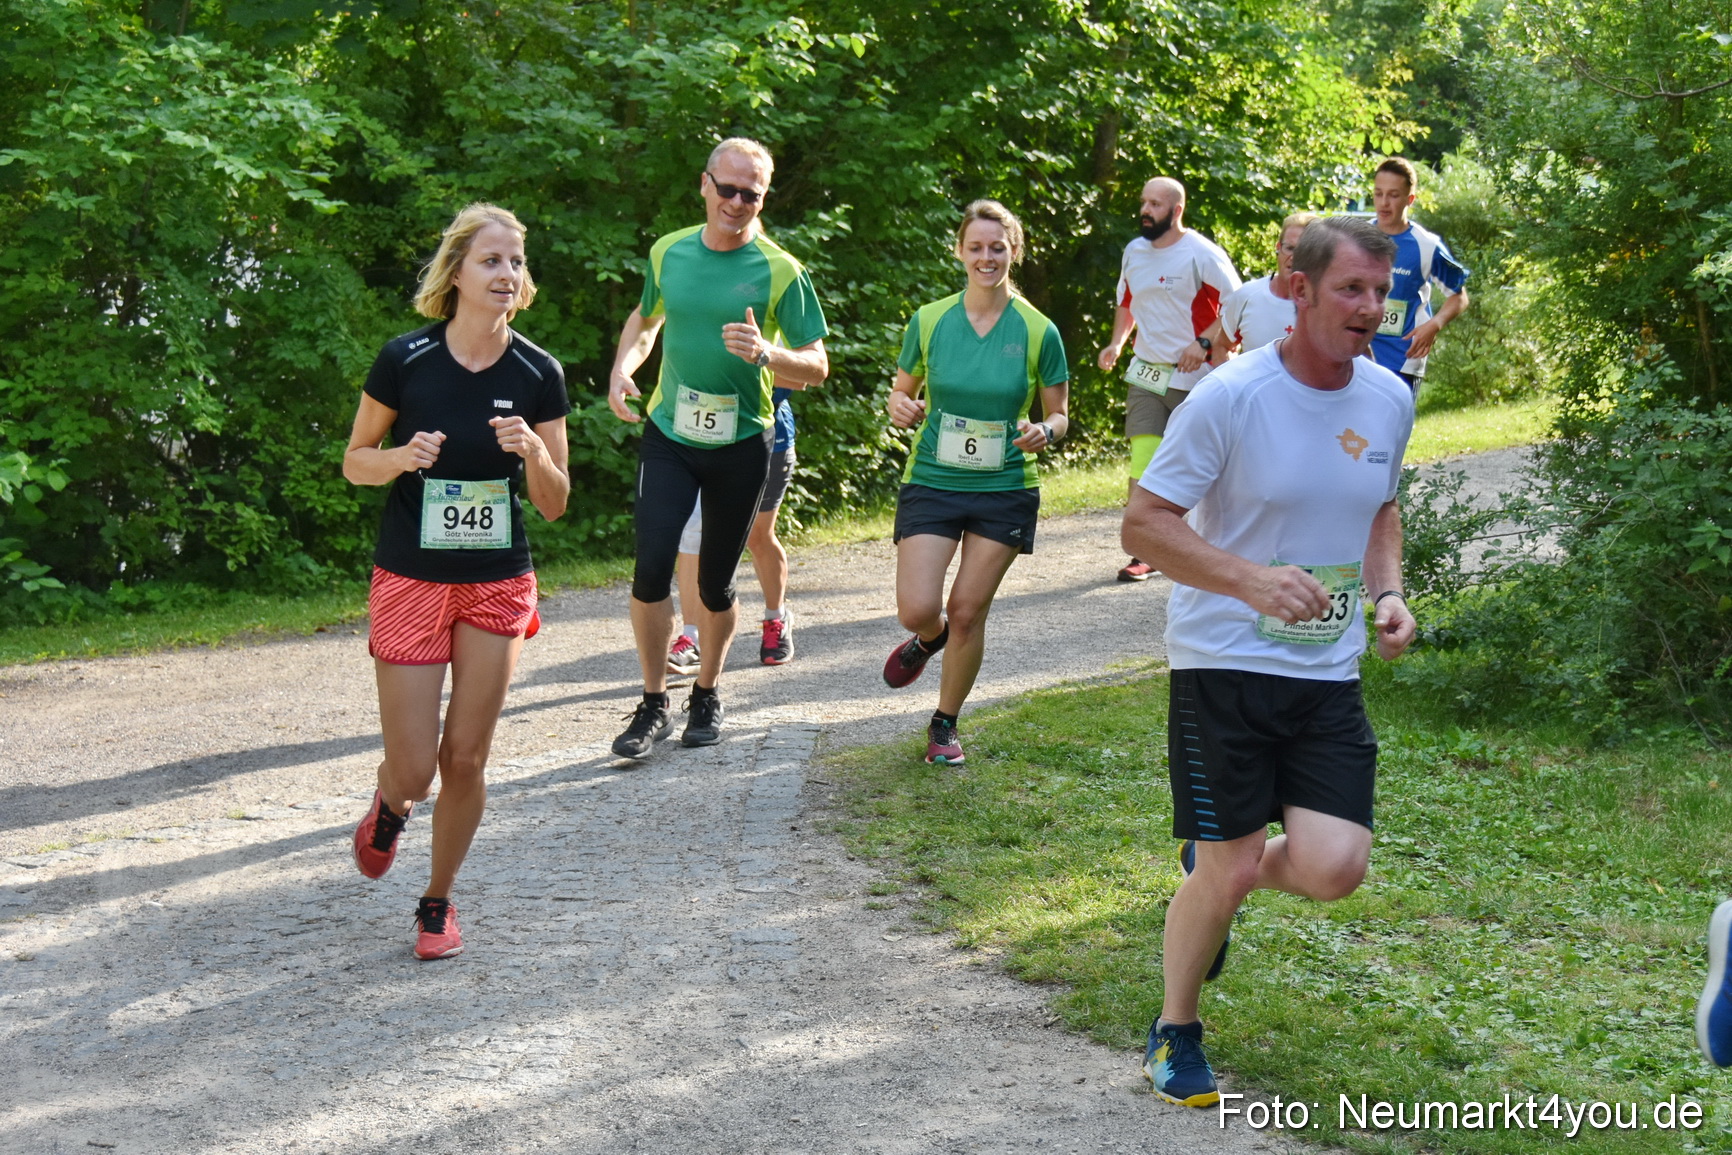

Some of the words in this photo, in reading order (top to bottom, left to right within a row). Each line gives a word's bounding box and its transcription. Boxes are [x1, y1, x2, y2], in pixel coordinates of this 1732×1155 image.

[1137, 365, 1161, 382] 378
[693, 410, 716, 430] 15
[965, 437, 977, 455] 6
[443, 505, 494, 530] 948
[1270, 627, 1306, 637] Landratsamt
[1315, 623, 1339, 631] Markus
